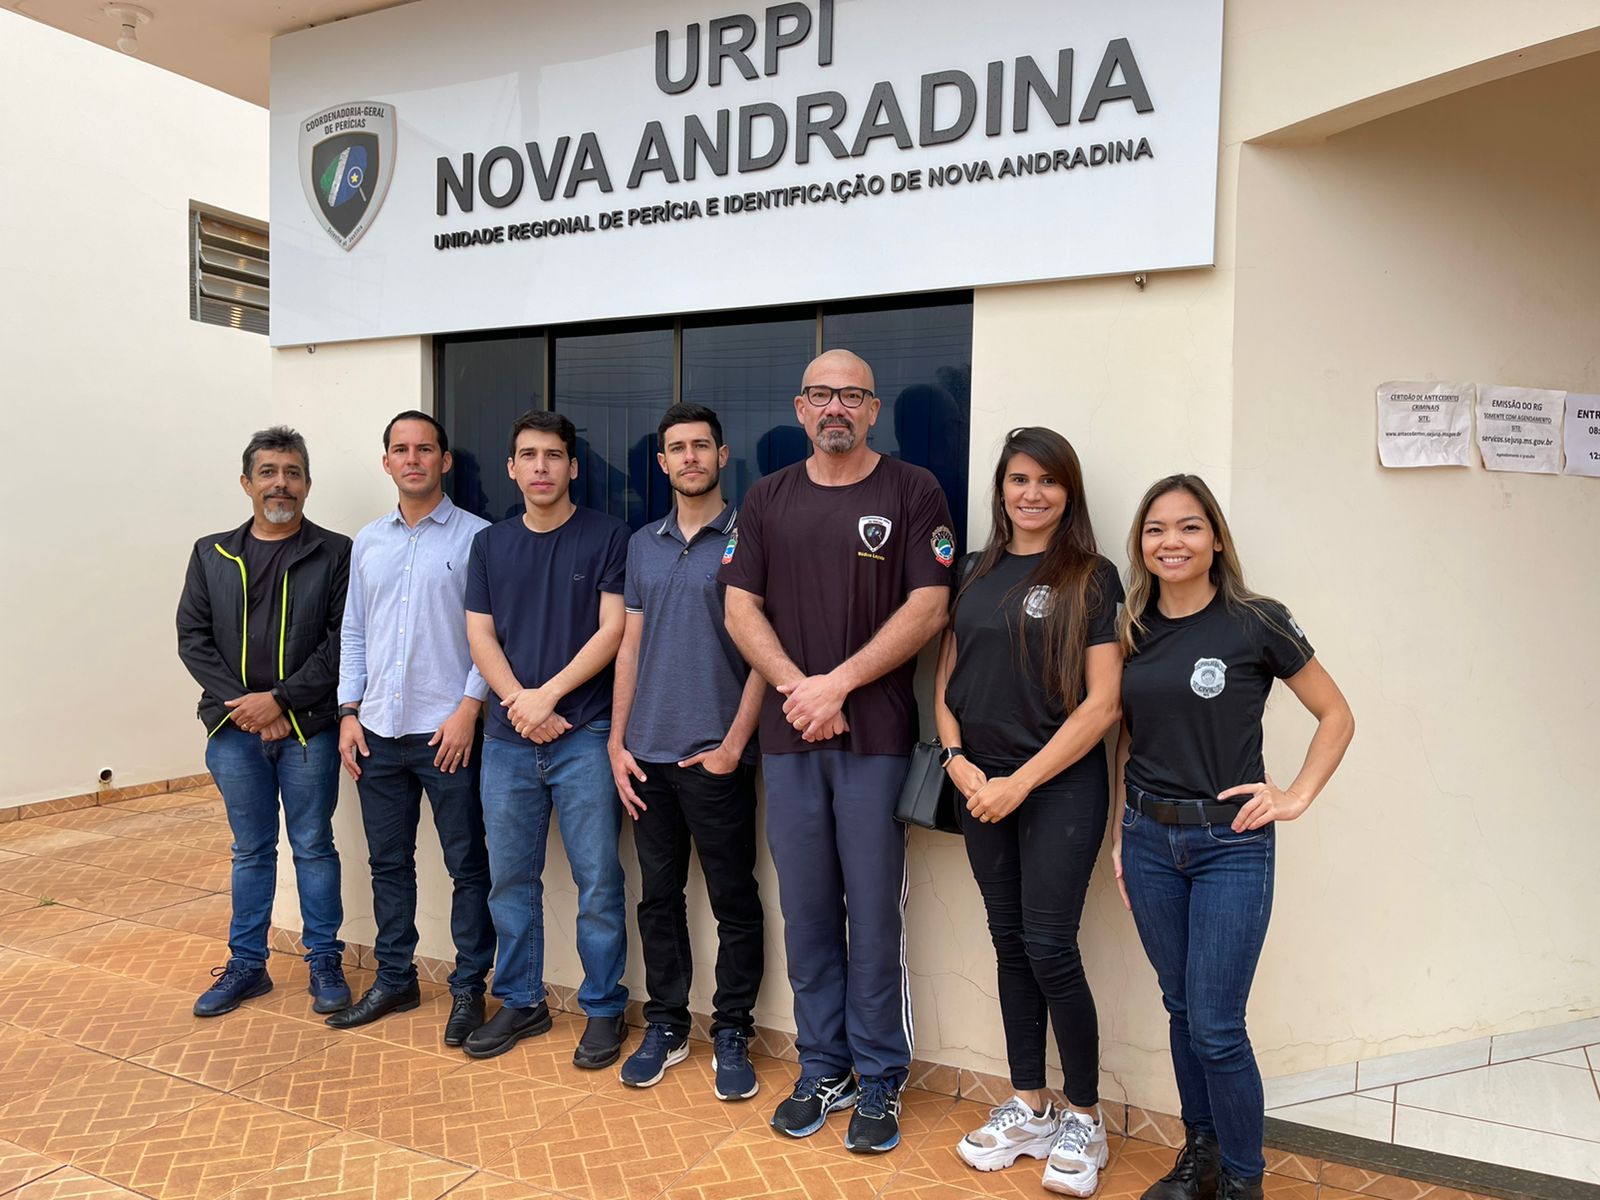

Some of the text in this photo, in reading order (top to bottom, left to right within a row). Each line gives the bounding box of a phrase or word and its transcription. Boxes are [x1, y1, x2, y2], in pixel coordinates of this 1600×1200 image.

[655, 0, 834, 95] URPI
[305, 106, 385, 133] COORDENADORIA-GERAL
[324, 118, 367, 135] DE PERÍCIAS
[436, 37, 1155, 216] NOVA ANDRADINA
[433, 136, 1154, 250] UNIDADE REGIONAL DE PERÍCIA E IDENTIFICAÇÃO DE NOVA ANDRADINA
[1390, 393, 1415, 401] CERTIDÃO
[1492, 400, 1543, 411] EMISSÃO DO RG
